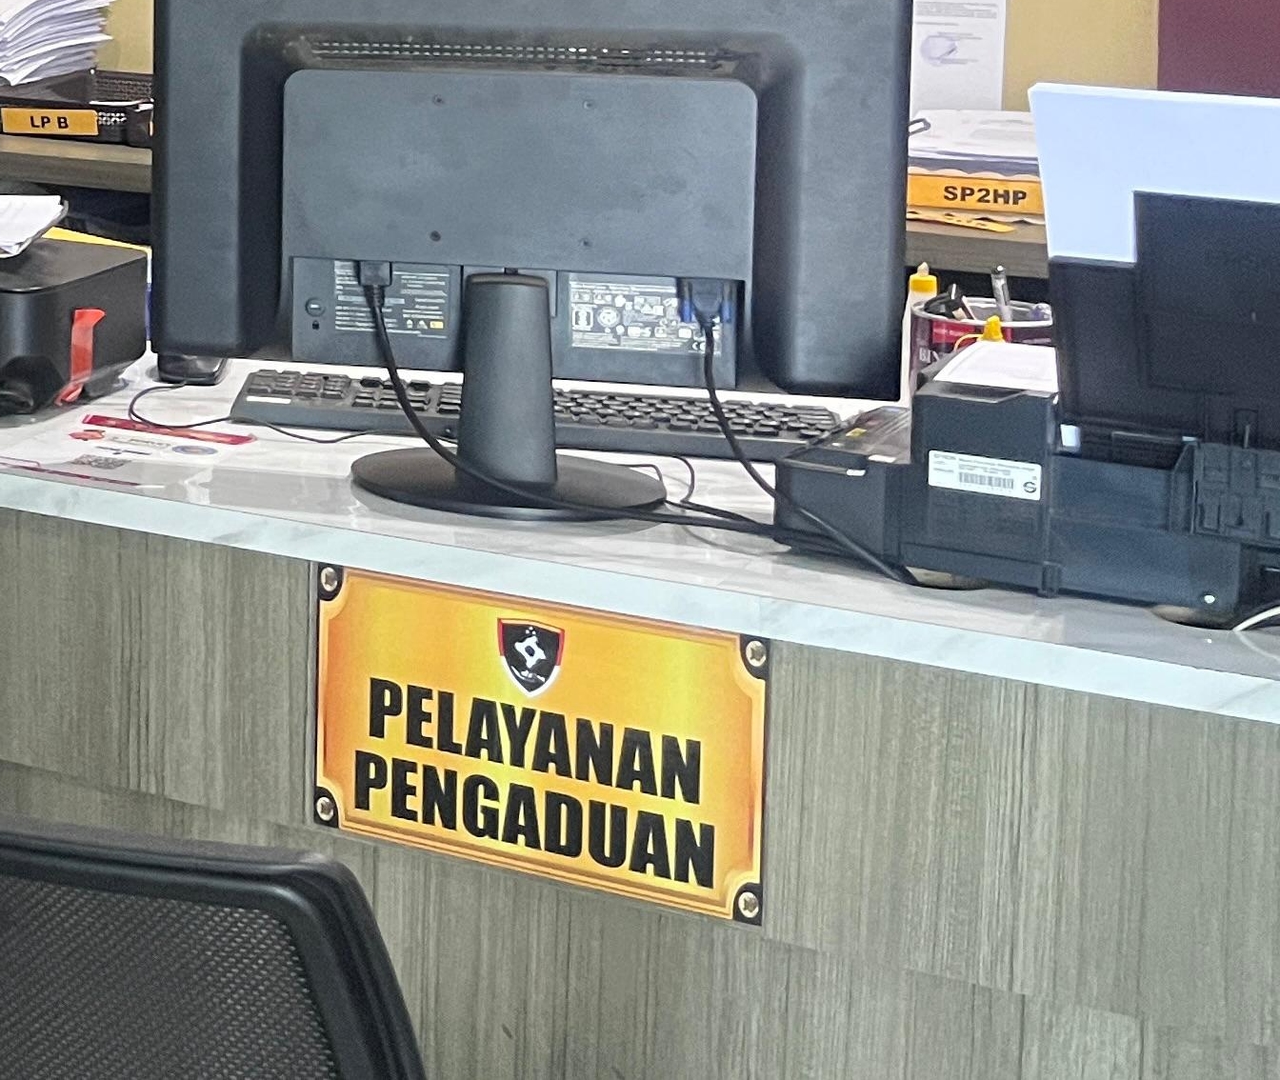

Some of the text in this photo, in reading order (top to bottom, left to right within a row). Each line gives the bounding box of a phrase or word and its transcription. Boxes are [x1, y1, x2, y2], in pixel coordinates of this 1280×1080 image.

[29, 115, 69, 129] LP B
[943, 185, 1027, 206] SP2HP
[368, 677, 701, 805] PELAYANAN
[354, 749, 716, 890] PENGADUAN
